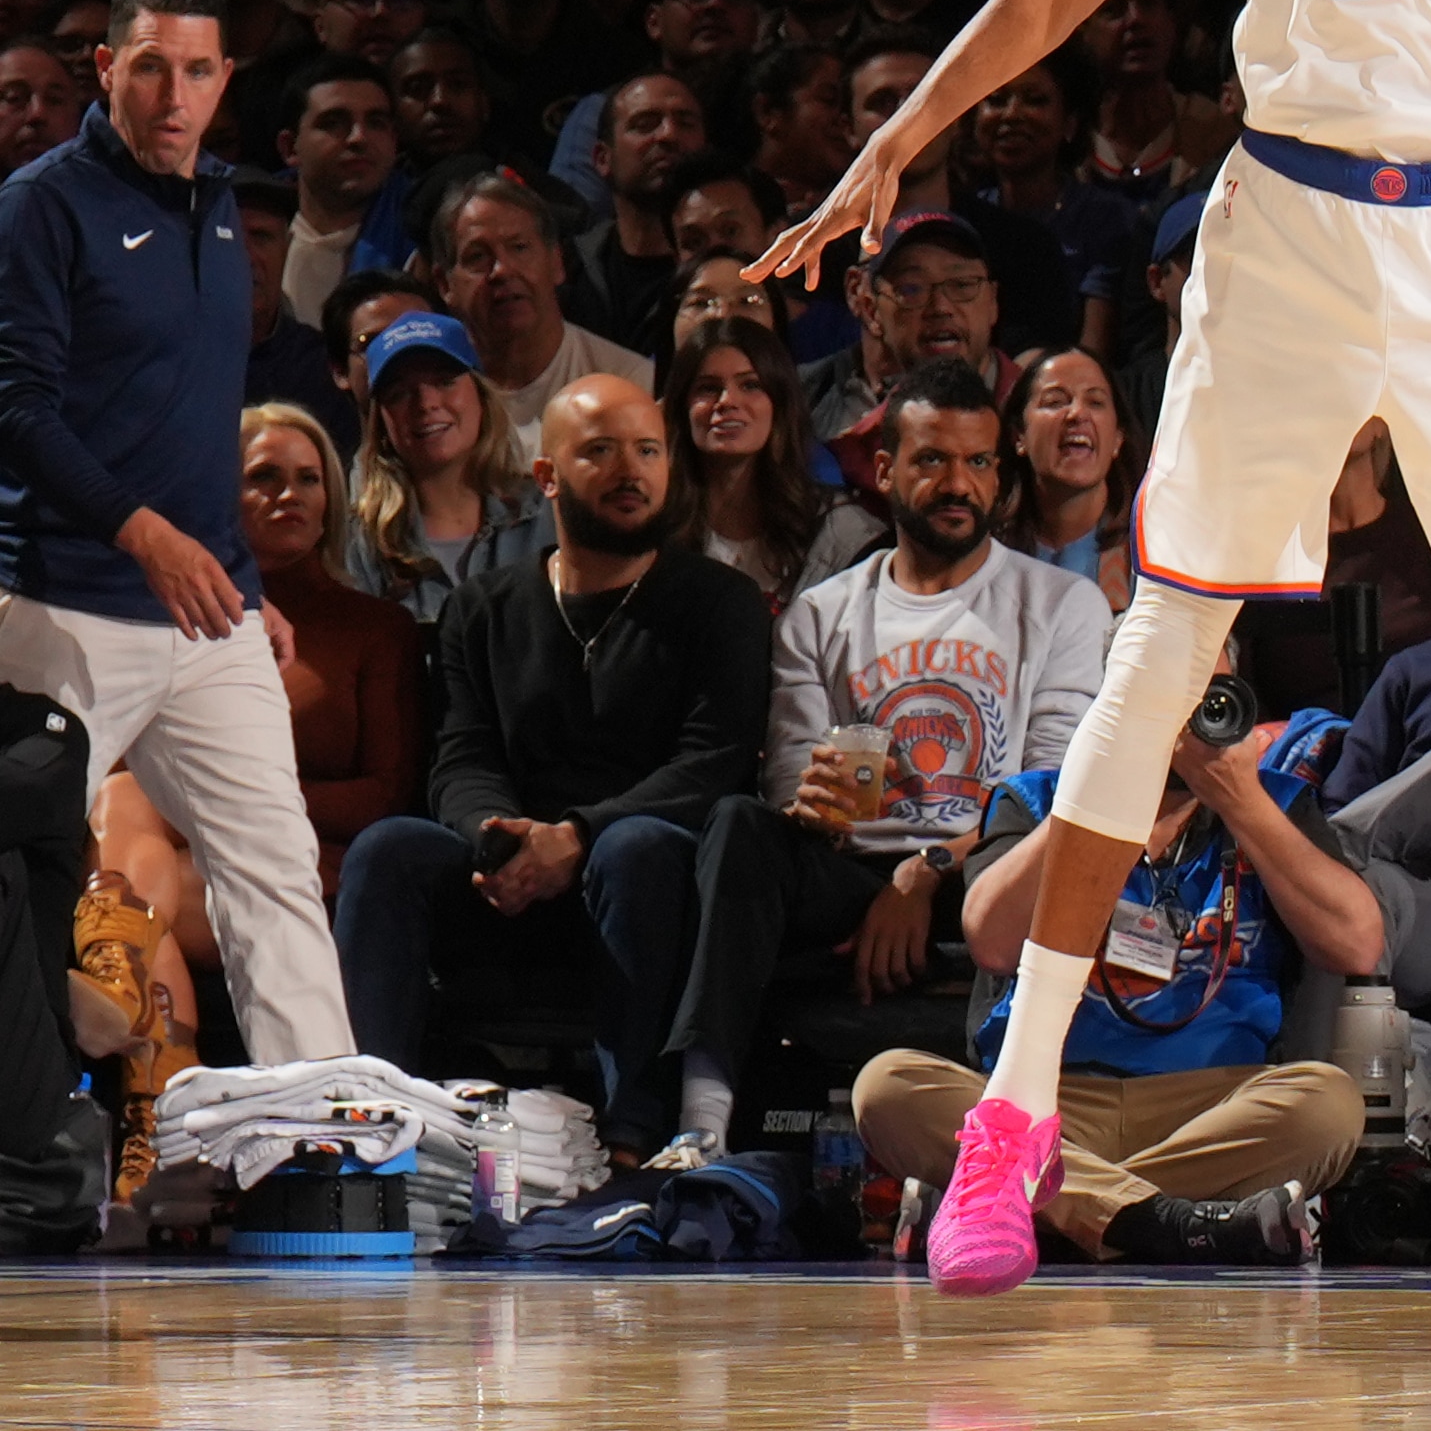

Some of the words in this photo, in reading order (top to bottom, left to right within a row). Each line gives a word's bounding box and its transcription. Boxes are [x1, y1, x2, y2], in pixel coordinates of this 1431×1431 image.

[848, 638, 1008, 703] KNICKS
[1223, 885, 1236, 923] EOS
[762, 1110, 813, 1133] SECTION
